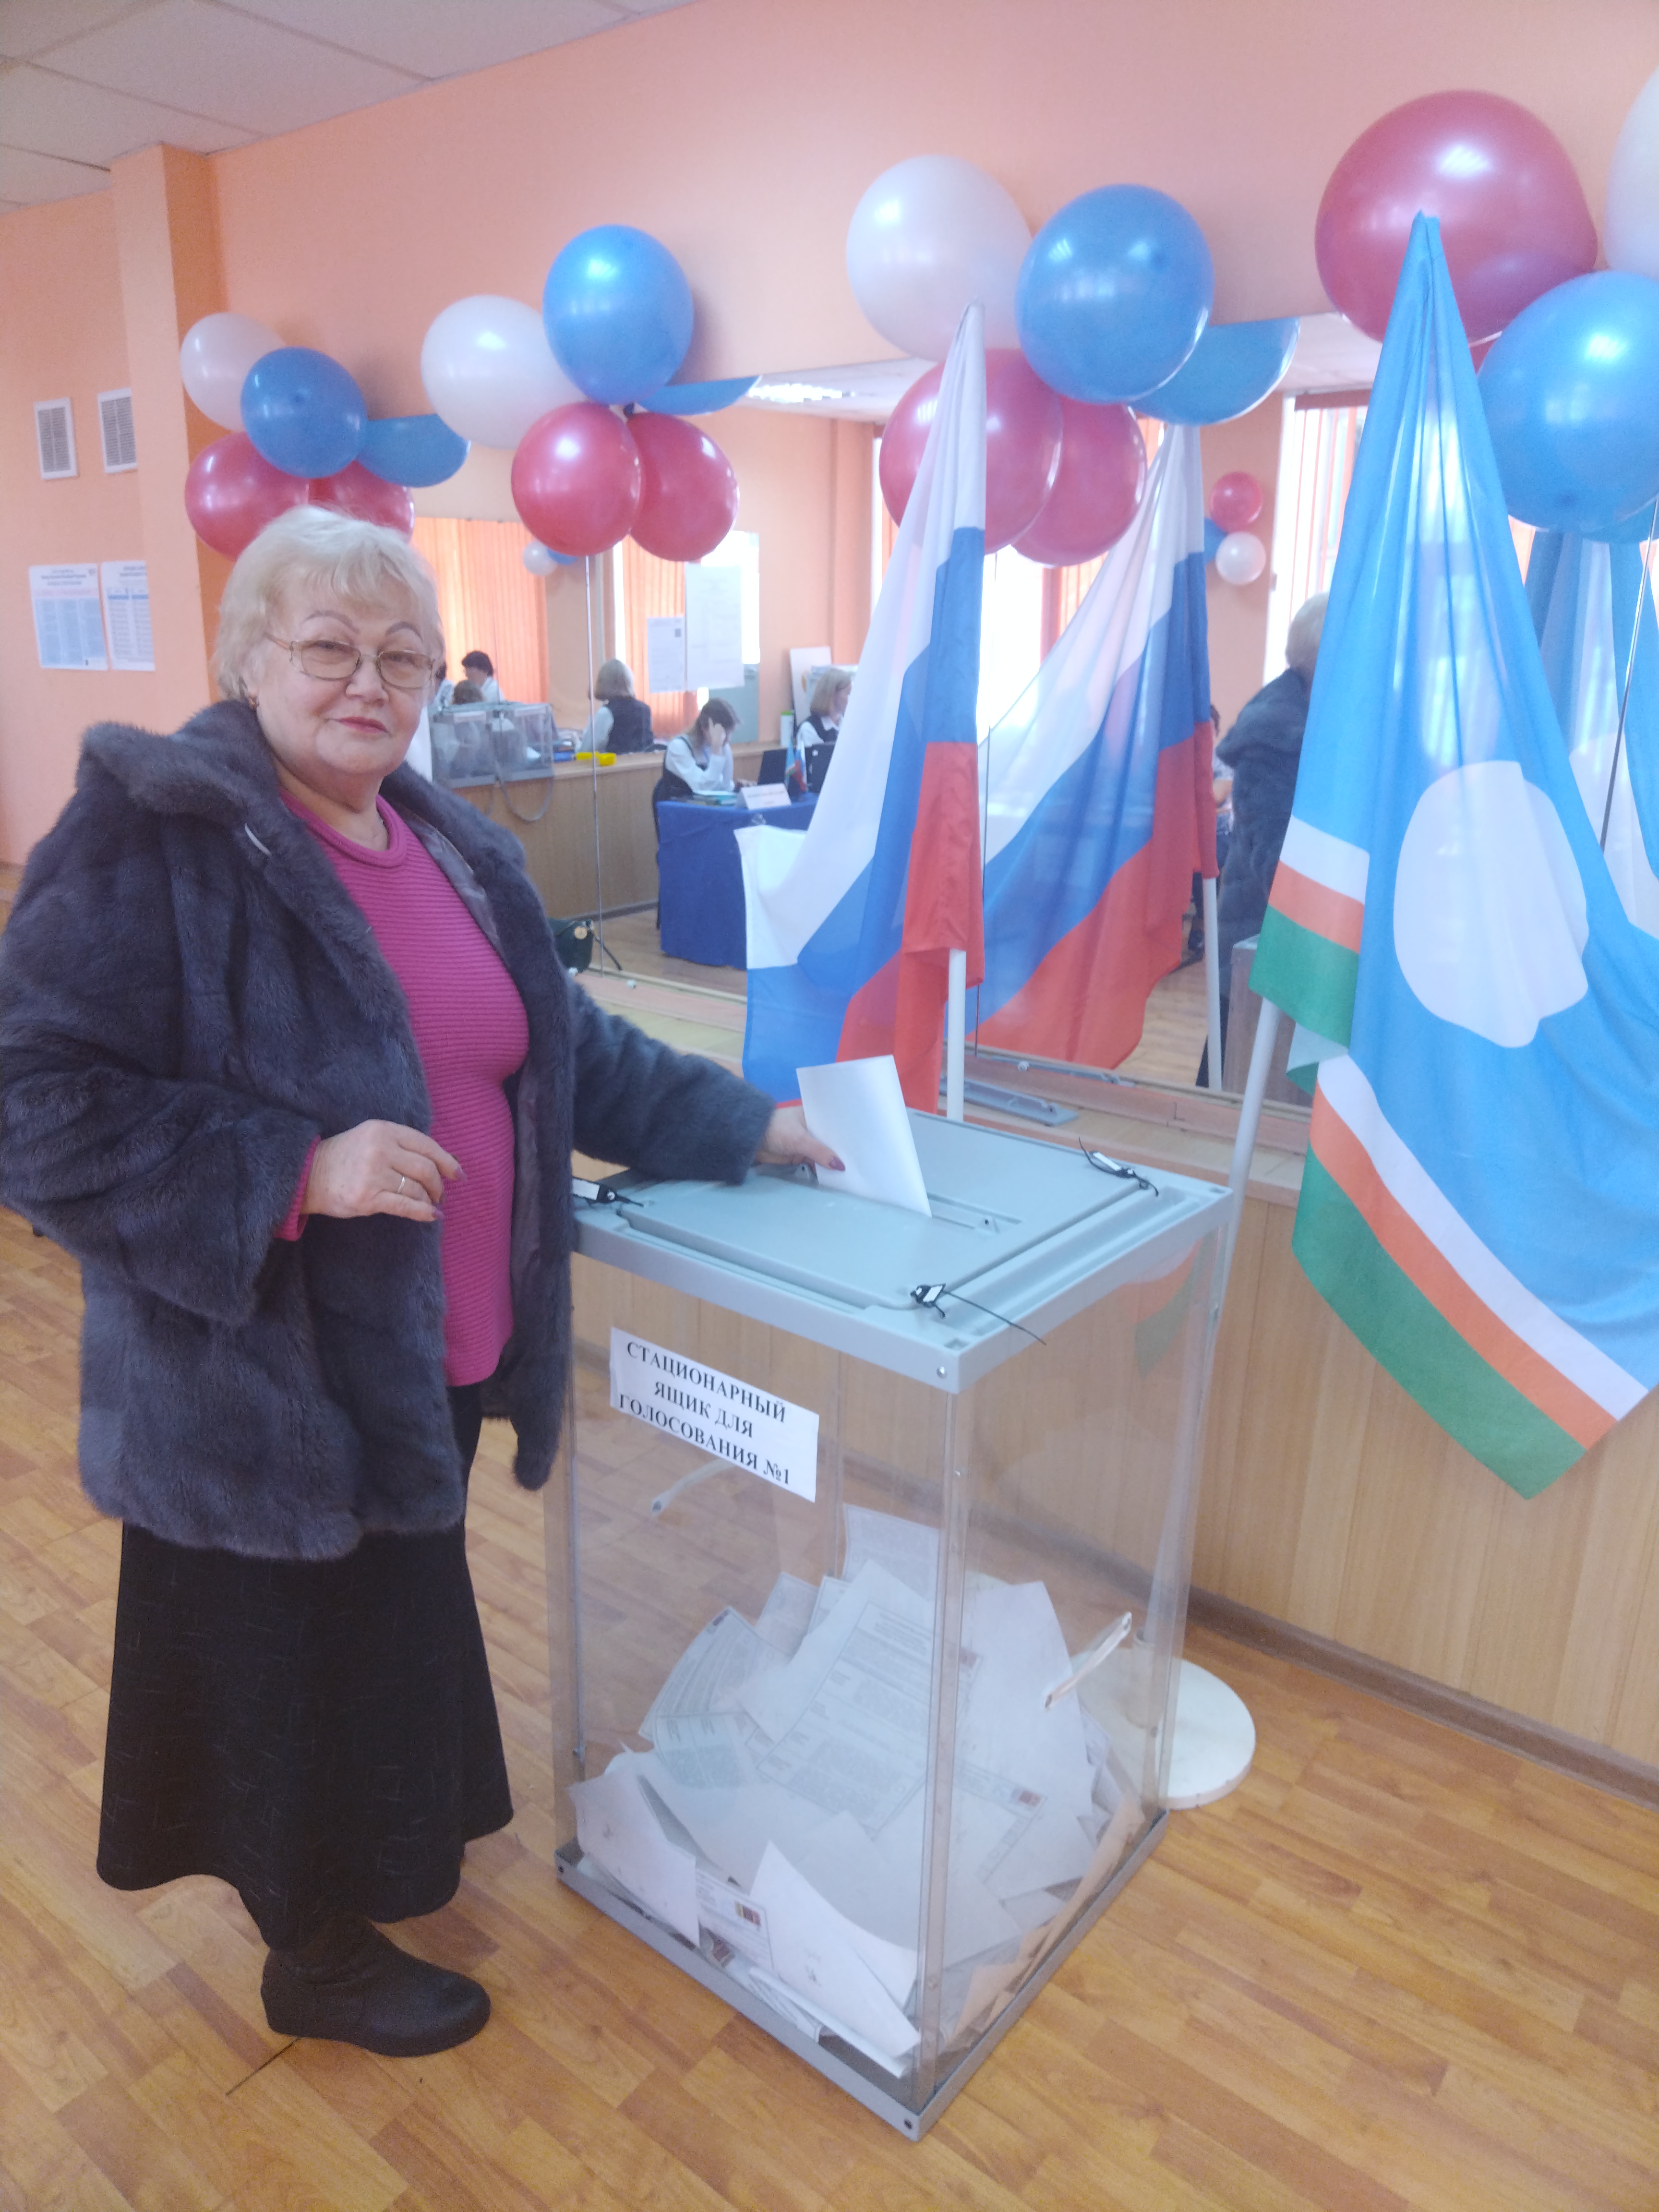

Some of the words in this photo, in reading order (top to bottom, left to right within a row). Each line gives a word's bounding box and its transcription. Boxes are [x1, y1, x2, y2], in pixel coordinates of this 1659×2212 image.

[627, 1341, 786, 1422] СТАЦИОНАРНЫЙ
[654, 1381, 711, 1419] ЯЩИК
[715, 1408, 753, 1438] ДЛЯ
[619, 1394, 758, 1469] ГОЛОСОВАНИЯ
[764, 1459, 789, 1484] №1
